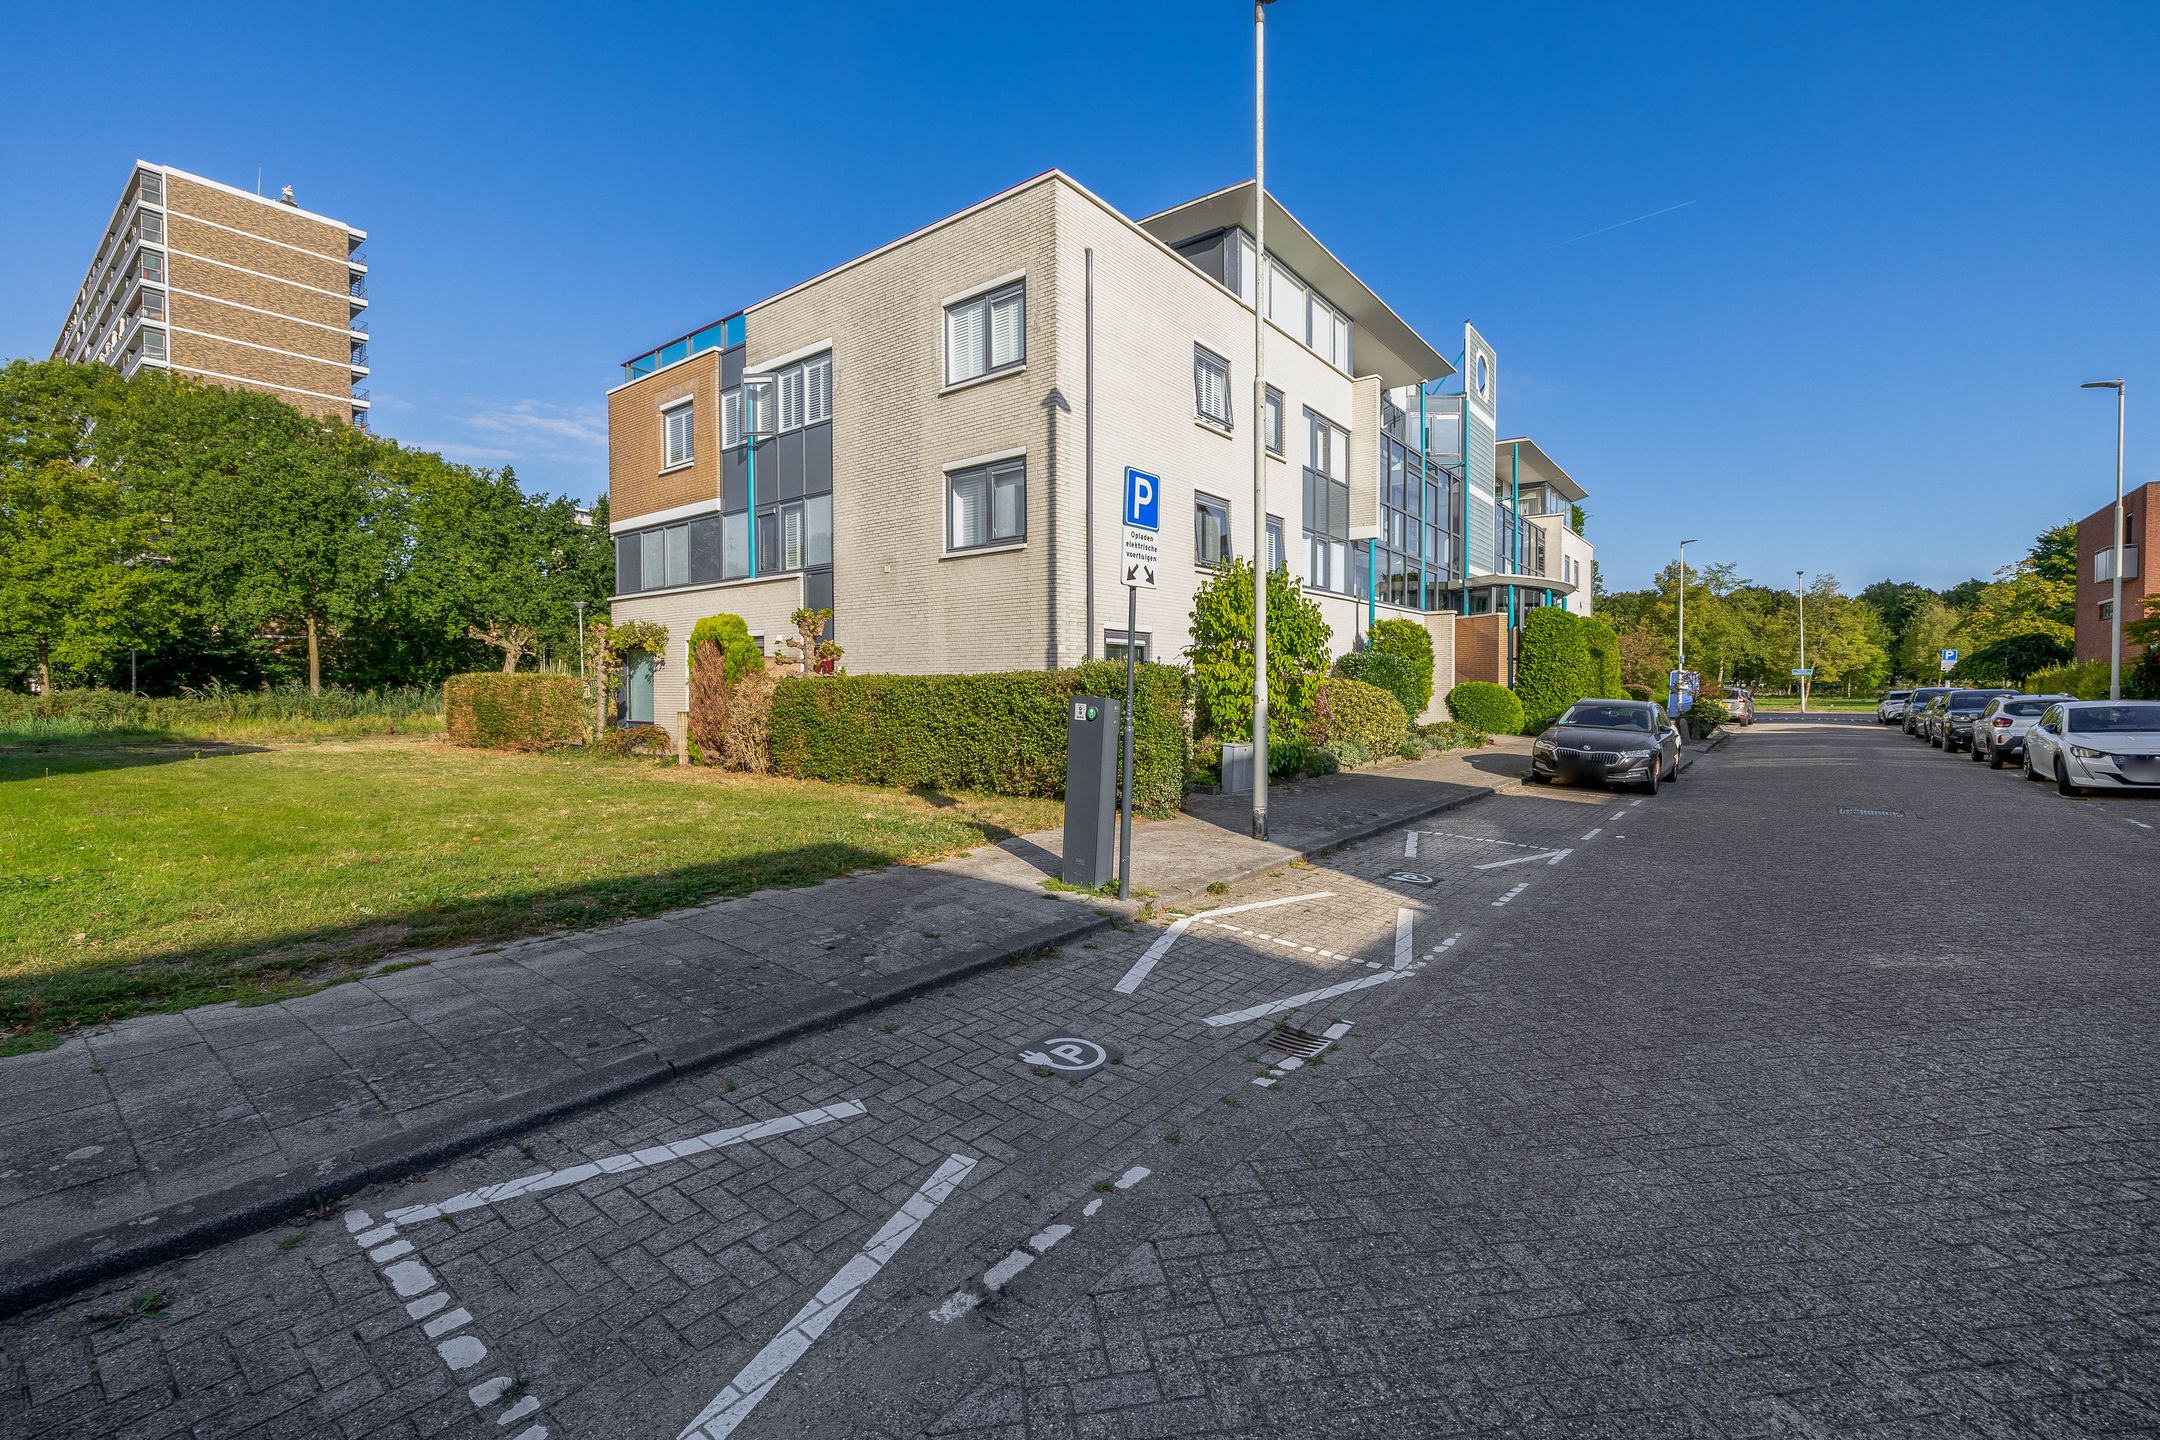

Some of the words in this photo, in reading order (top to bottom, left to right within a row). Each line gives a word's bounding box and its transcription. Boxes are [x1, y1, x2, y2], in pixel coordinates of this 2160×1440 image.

[1134, 476, 1153, 519] P
[1131, 530, 1154, 542] Opladen
[1126, 541, 1157, 553] elektrische
[1126, 552, 1157, 563] voertuigen
[1945, 650, 1954, 659] P
[1050, 1044, 1085, 1065] P
